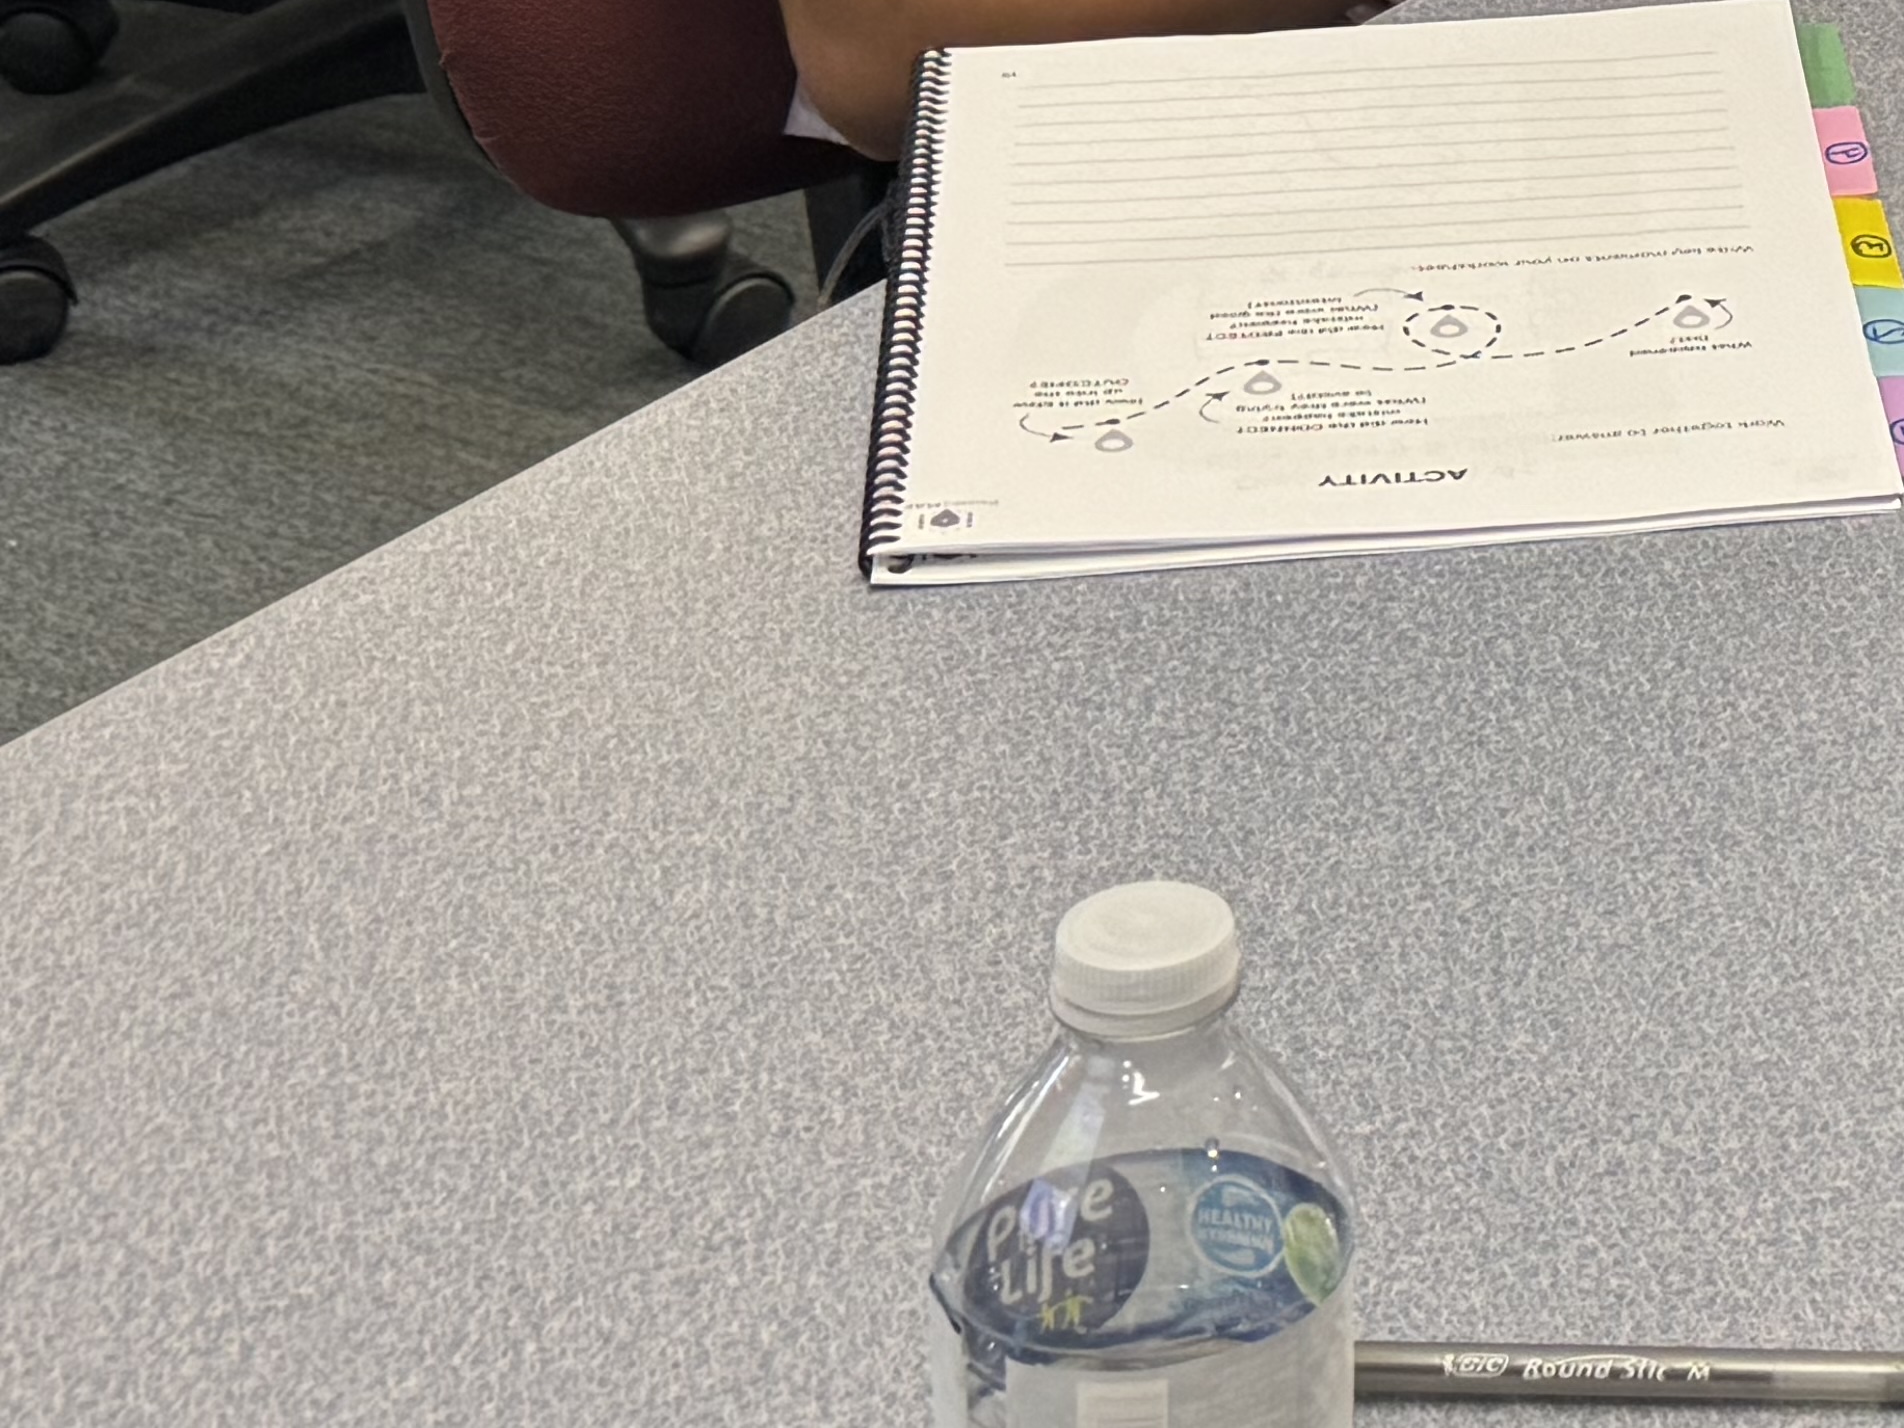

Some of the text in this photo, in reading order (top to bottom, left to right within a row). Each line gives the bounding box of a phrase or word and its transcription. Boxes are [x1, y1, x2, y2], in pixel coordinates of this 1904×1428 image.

[1317, 468, 1468, 488] ACTIVITY
[1197, 1207, 1274, 1234] HEALTHY
[1000, 1235, 1096, 1305] Life
[1522, 1357, 1612, 1381] Round
[1686, 1360, 1712, 1382] M
